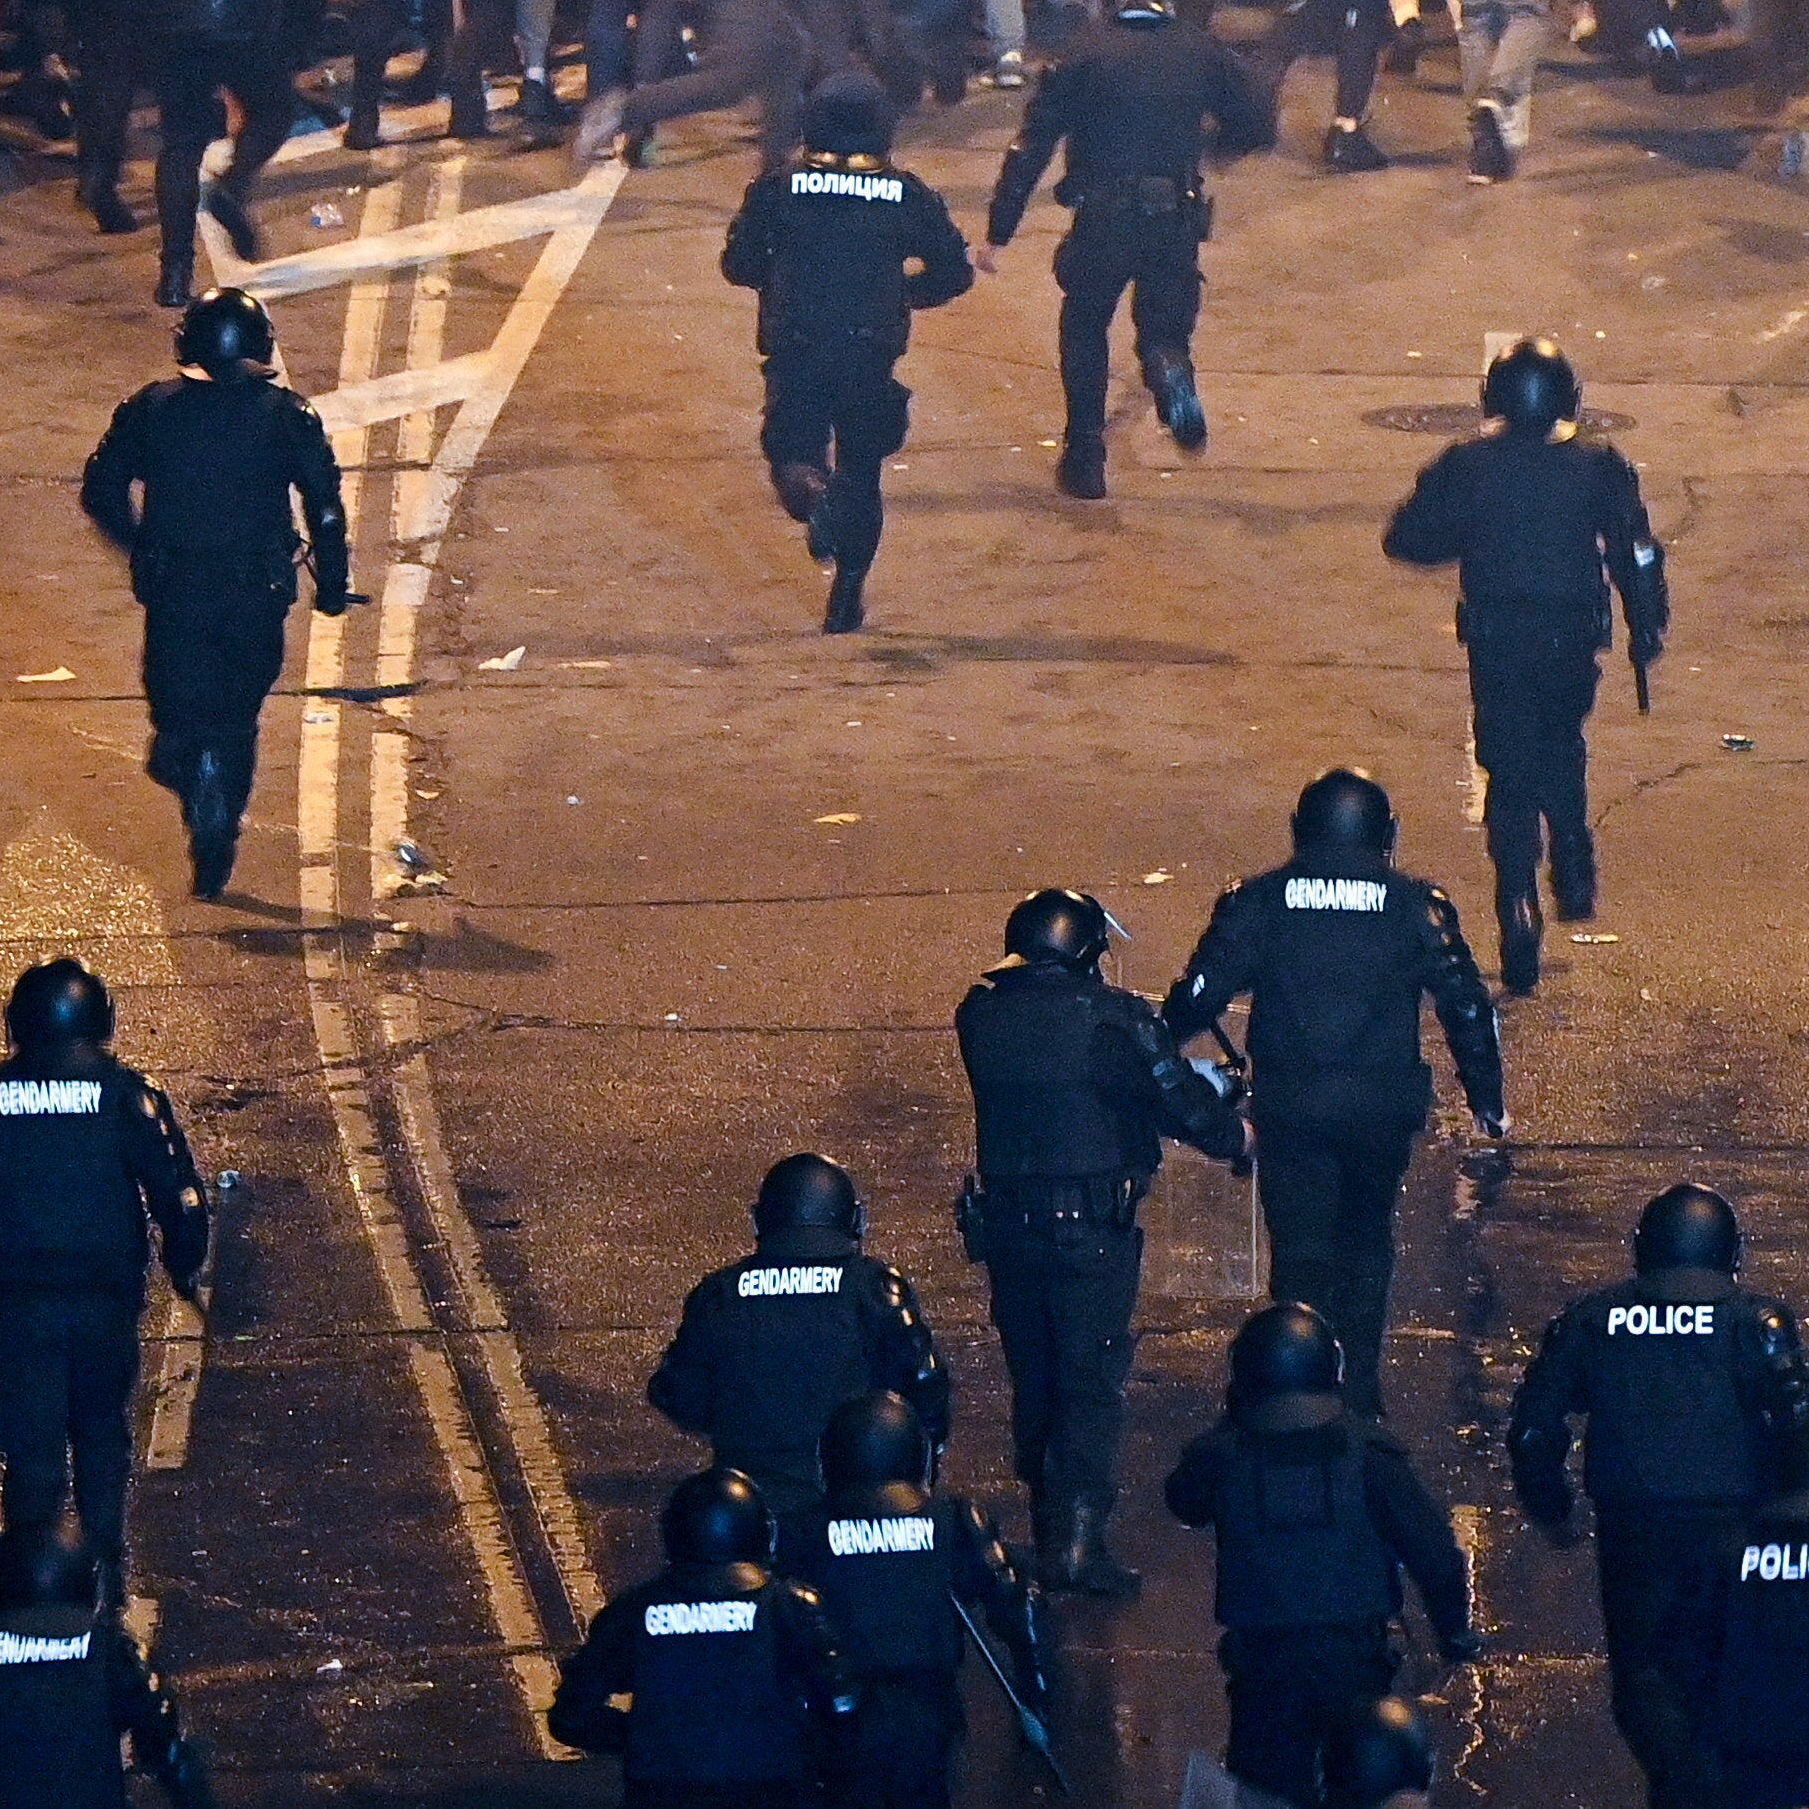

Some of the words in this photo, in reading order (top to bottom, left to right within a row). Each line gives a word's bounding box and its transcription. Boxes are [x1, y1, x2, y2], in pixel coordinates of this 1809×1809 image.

[791, 172, 903, 203] ПОЛИЦИЯ
[1284, 877, 1388, 912] GENDARMERY
[737, 1266, 844, 1298] GENDARMERY
[1607, 1304, 1715, 1336] POLICE
[827, 1516, 935, 1557] GENDARMERY
[644, 1600, 758, 1636] GENDARMERY
